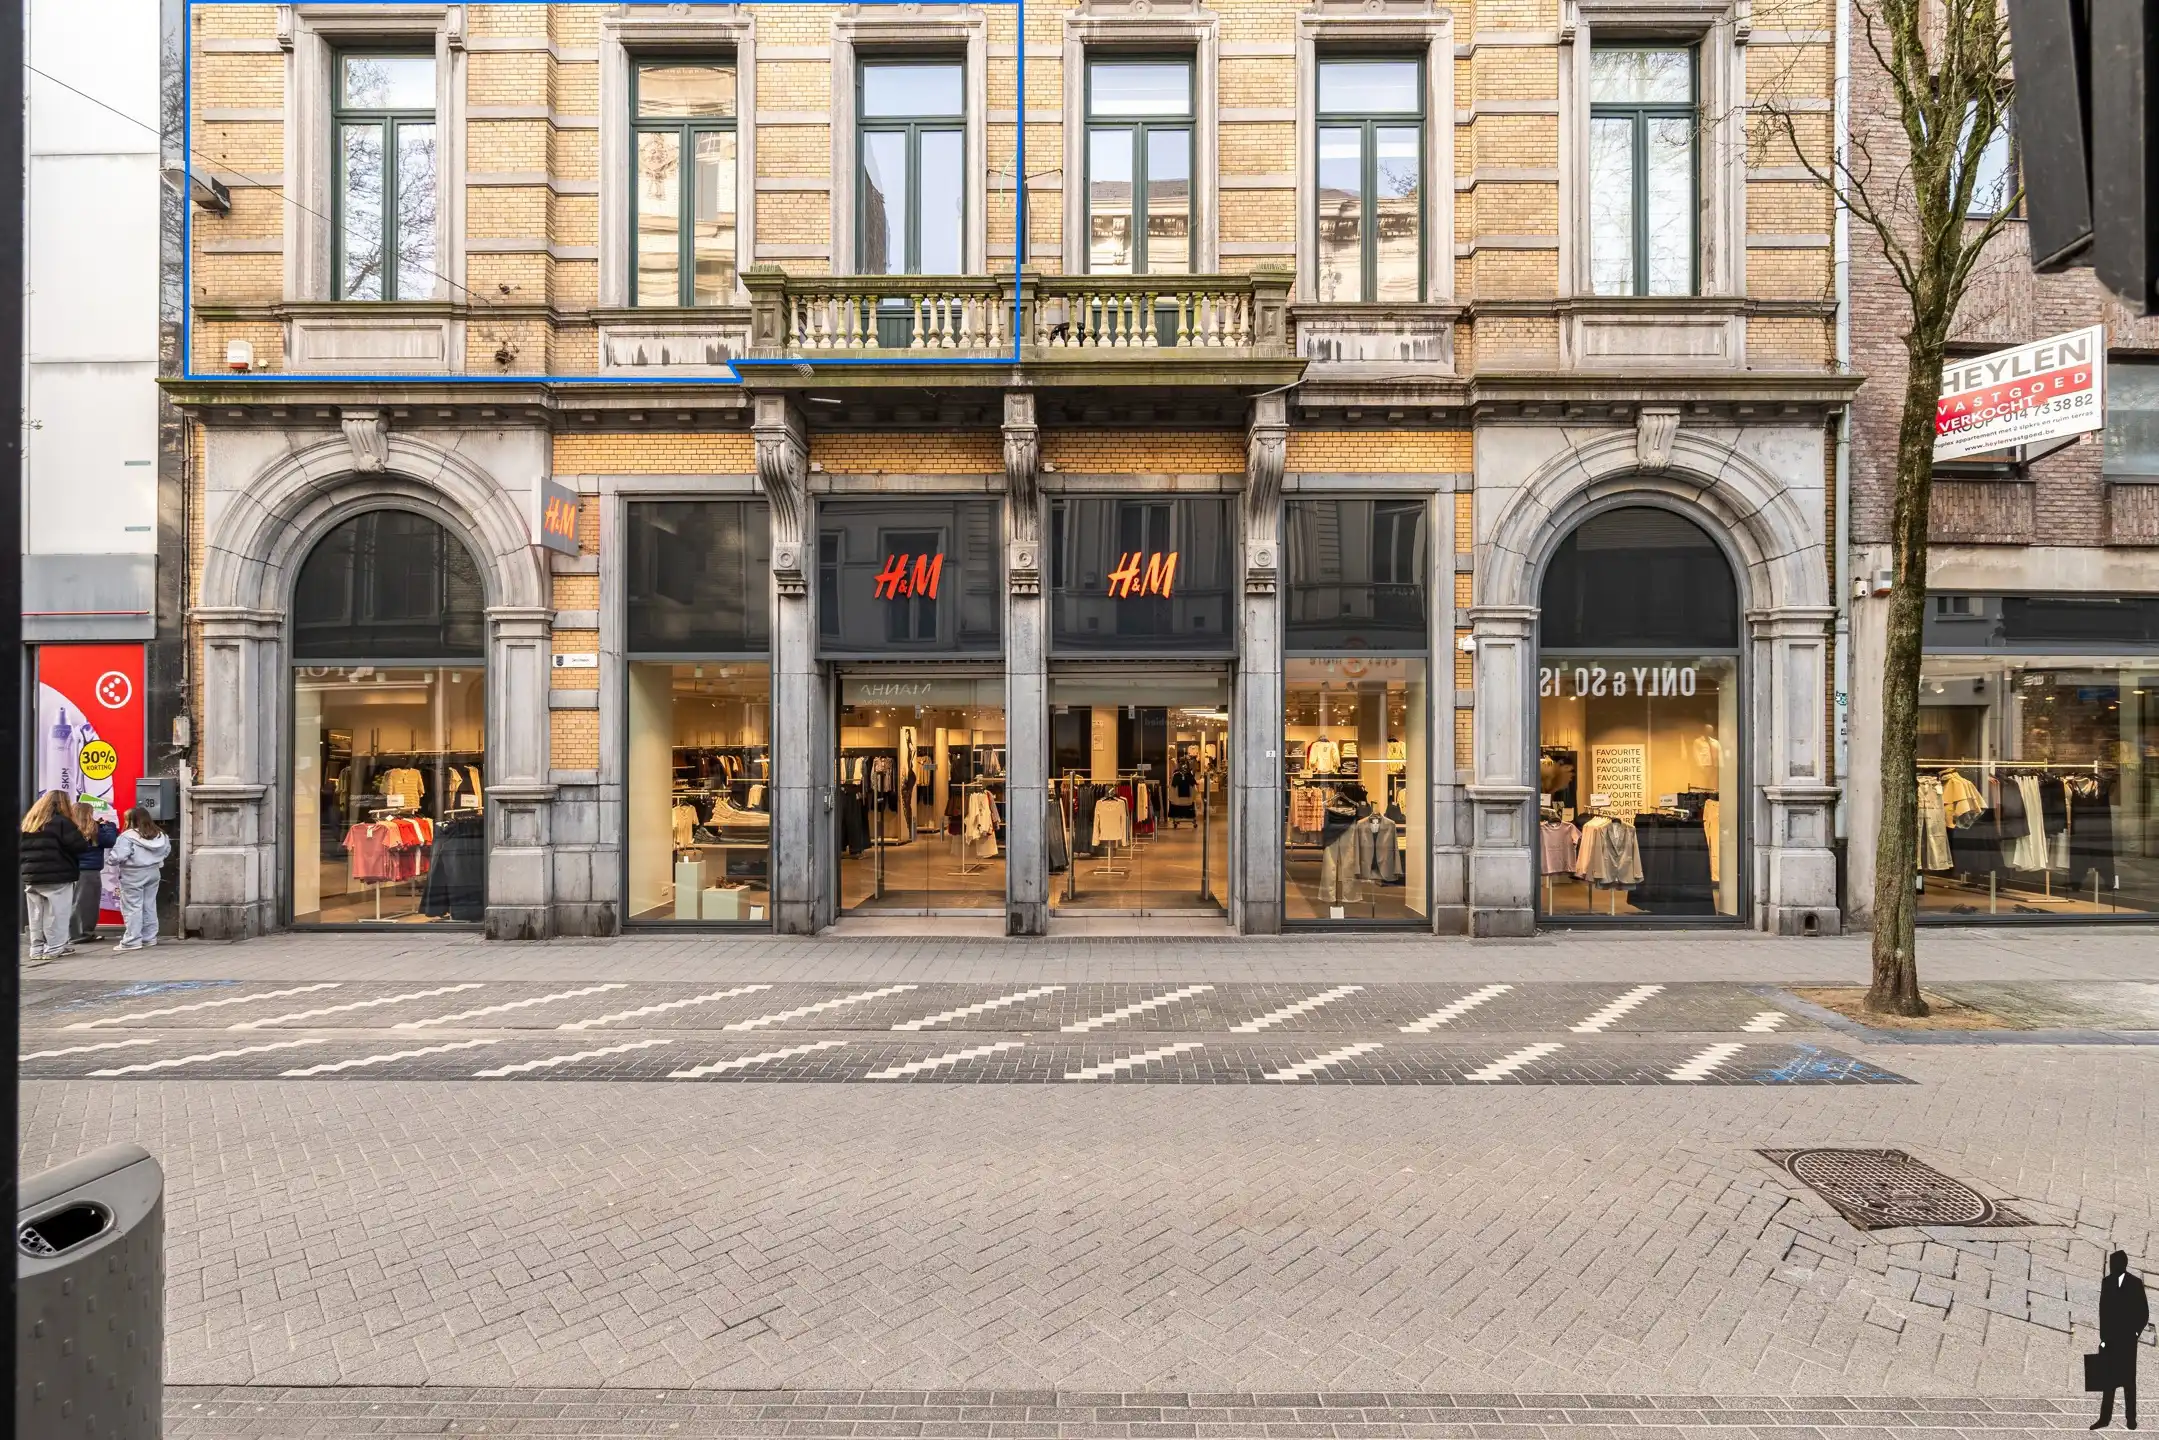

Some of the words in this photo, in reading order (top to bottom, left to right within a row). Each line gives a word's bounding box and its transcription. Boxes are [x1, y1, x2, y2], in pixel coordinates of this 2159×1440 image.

[1941, 338, 2086, 394] HEYLEN
[1937, 372, 2087, 416] VASTGOED
[2053, 398, 2072, 412] 38
[2074, 393, 2093, 407] 82
[1939, 394, 2036, 432] VERKOCHT
[1964, 428, 2055, 452] www.heylenvastgoed.be
[544, 495, 577, 542] H&M
[873, 552, 945, 601] H&M
[1107, 551, 1178, 600] H&M
[82, 750, 115, 764] 30%
[1596, 748, 1641, 756] FAVOURITE
[1596, 757, 1641, 765] FAVOURITE
[62, 768, 70, 789] SKIN
[145, 798, 155, 808] 3B
